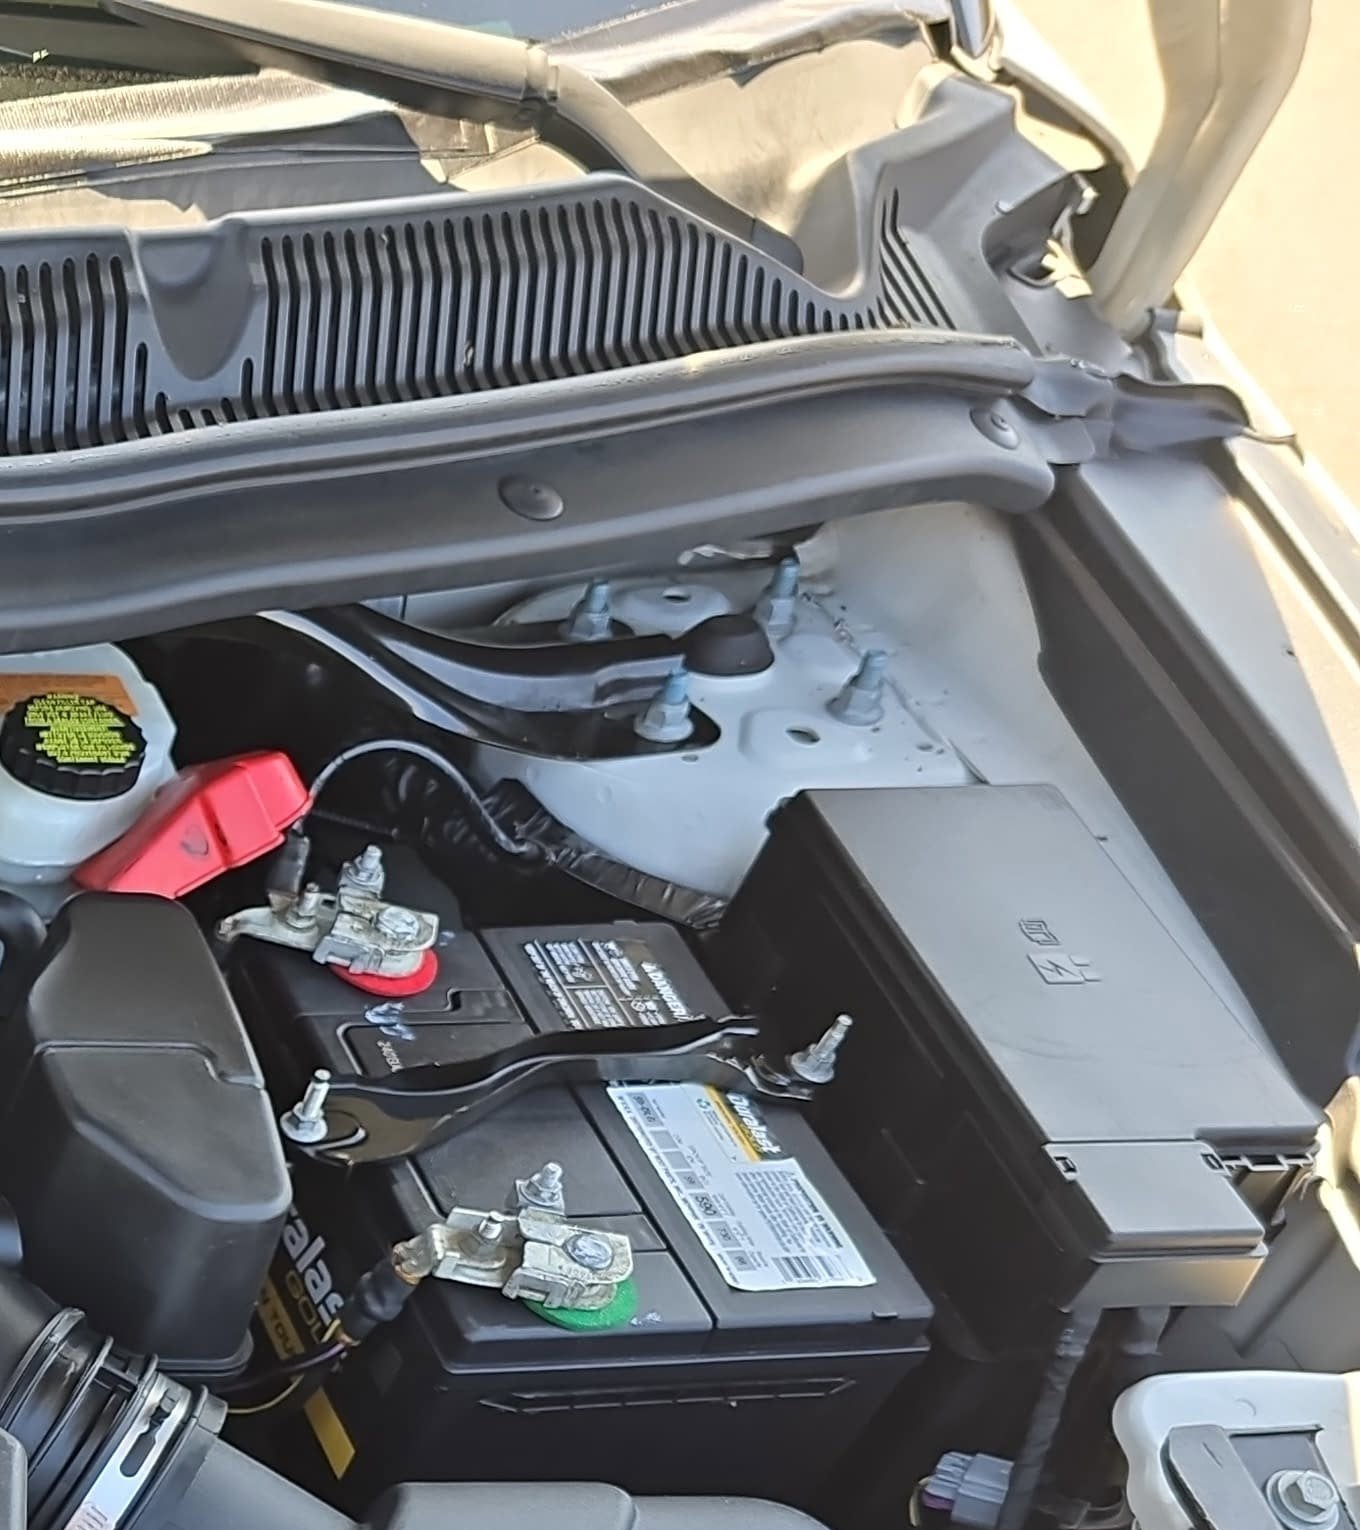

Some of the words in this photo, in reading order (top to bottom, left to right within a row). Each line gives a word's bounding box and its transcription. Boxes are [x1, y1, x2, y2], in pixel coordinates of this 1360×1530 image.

[723, 1092, 784, 1154] Duralast
[283, 1206, 344, 1327] alas
[286, 1270, 321, 1344] GOL
